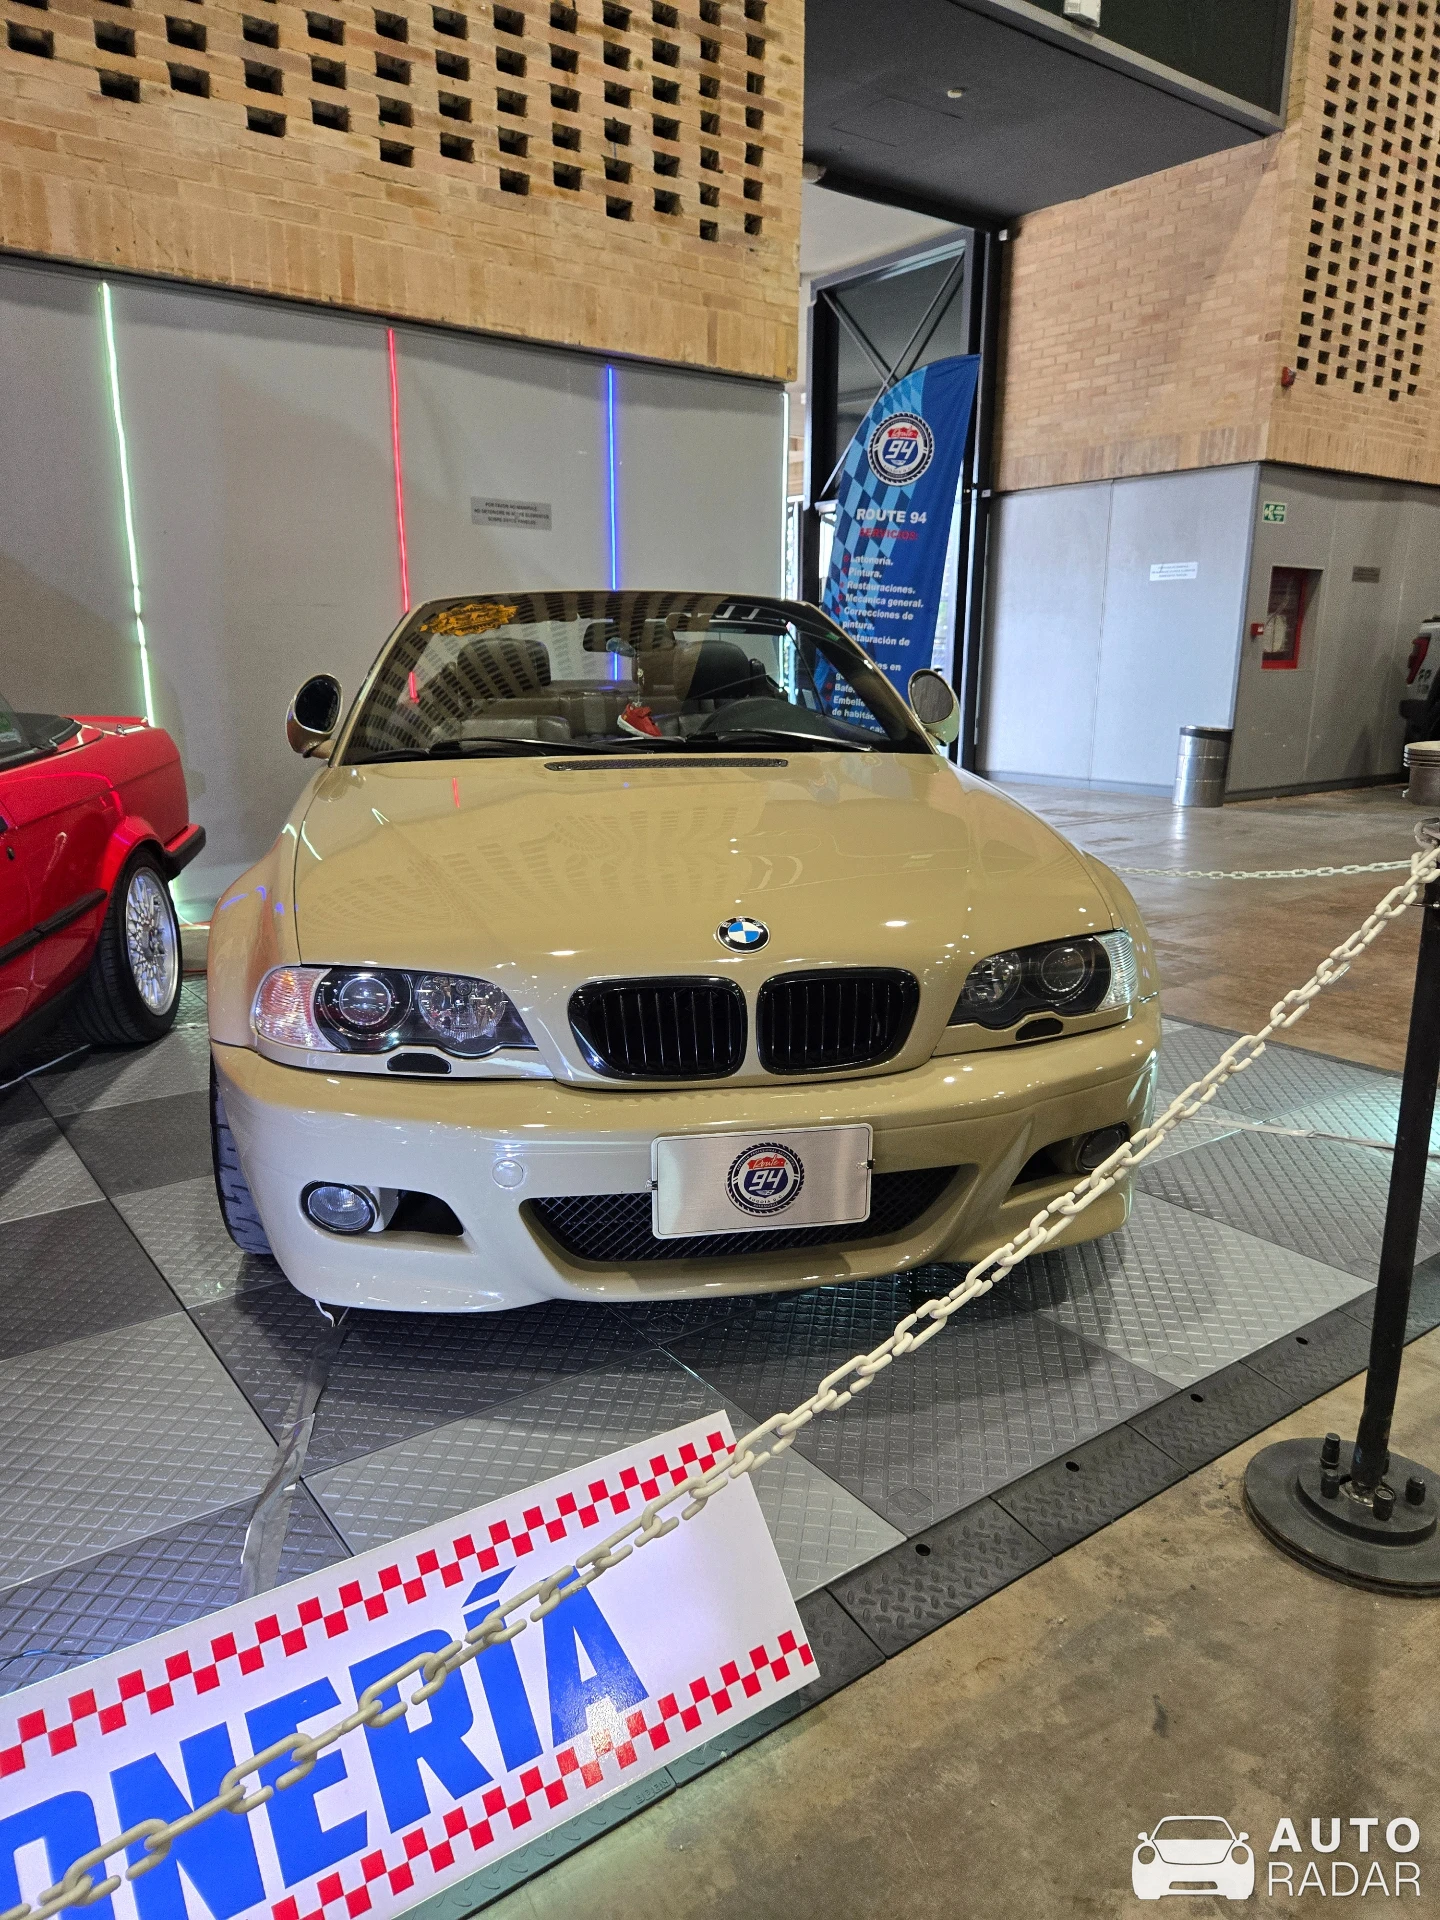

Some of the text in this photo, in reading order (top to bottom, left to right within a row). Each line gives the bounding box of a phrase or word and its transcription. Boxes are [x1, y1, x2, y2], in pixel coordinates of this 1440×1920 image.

[885, 440, 917, 460] 94
[856, 508, 927, 524] ROUTE 94
[848, 567, 882, 578] Pintura.
[847, 581, 916, 595] Restauraciones.
[887, 598, 924, 608] general.
[844, 606, 914, 620] Correcciones de
[842, 619, 875, 631] pintura.
[850, 634, 910, 646] stauración de
[889, 663, 901, 671] en
[831, 708, 876, 720] de habitác
[752, 1153, 780, 1170] Route
[748, 1169, 785, 1191] 94
